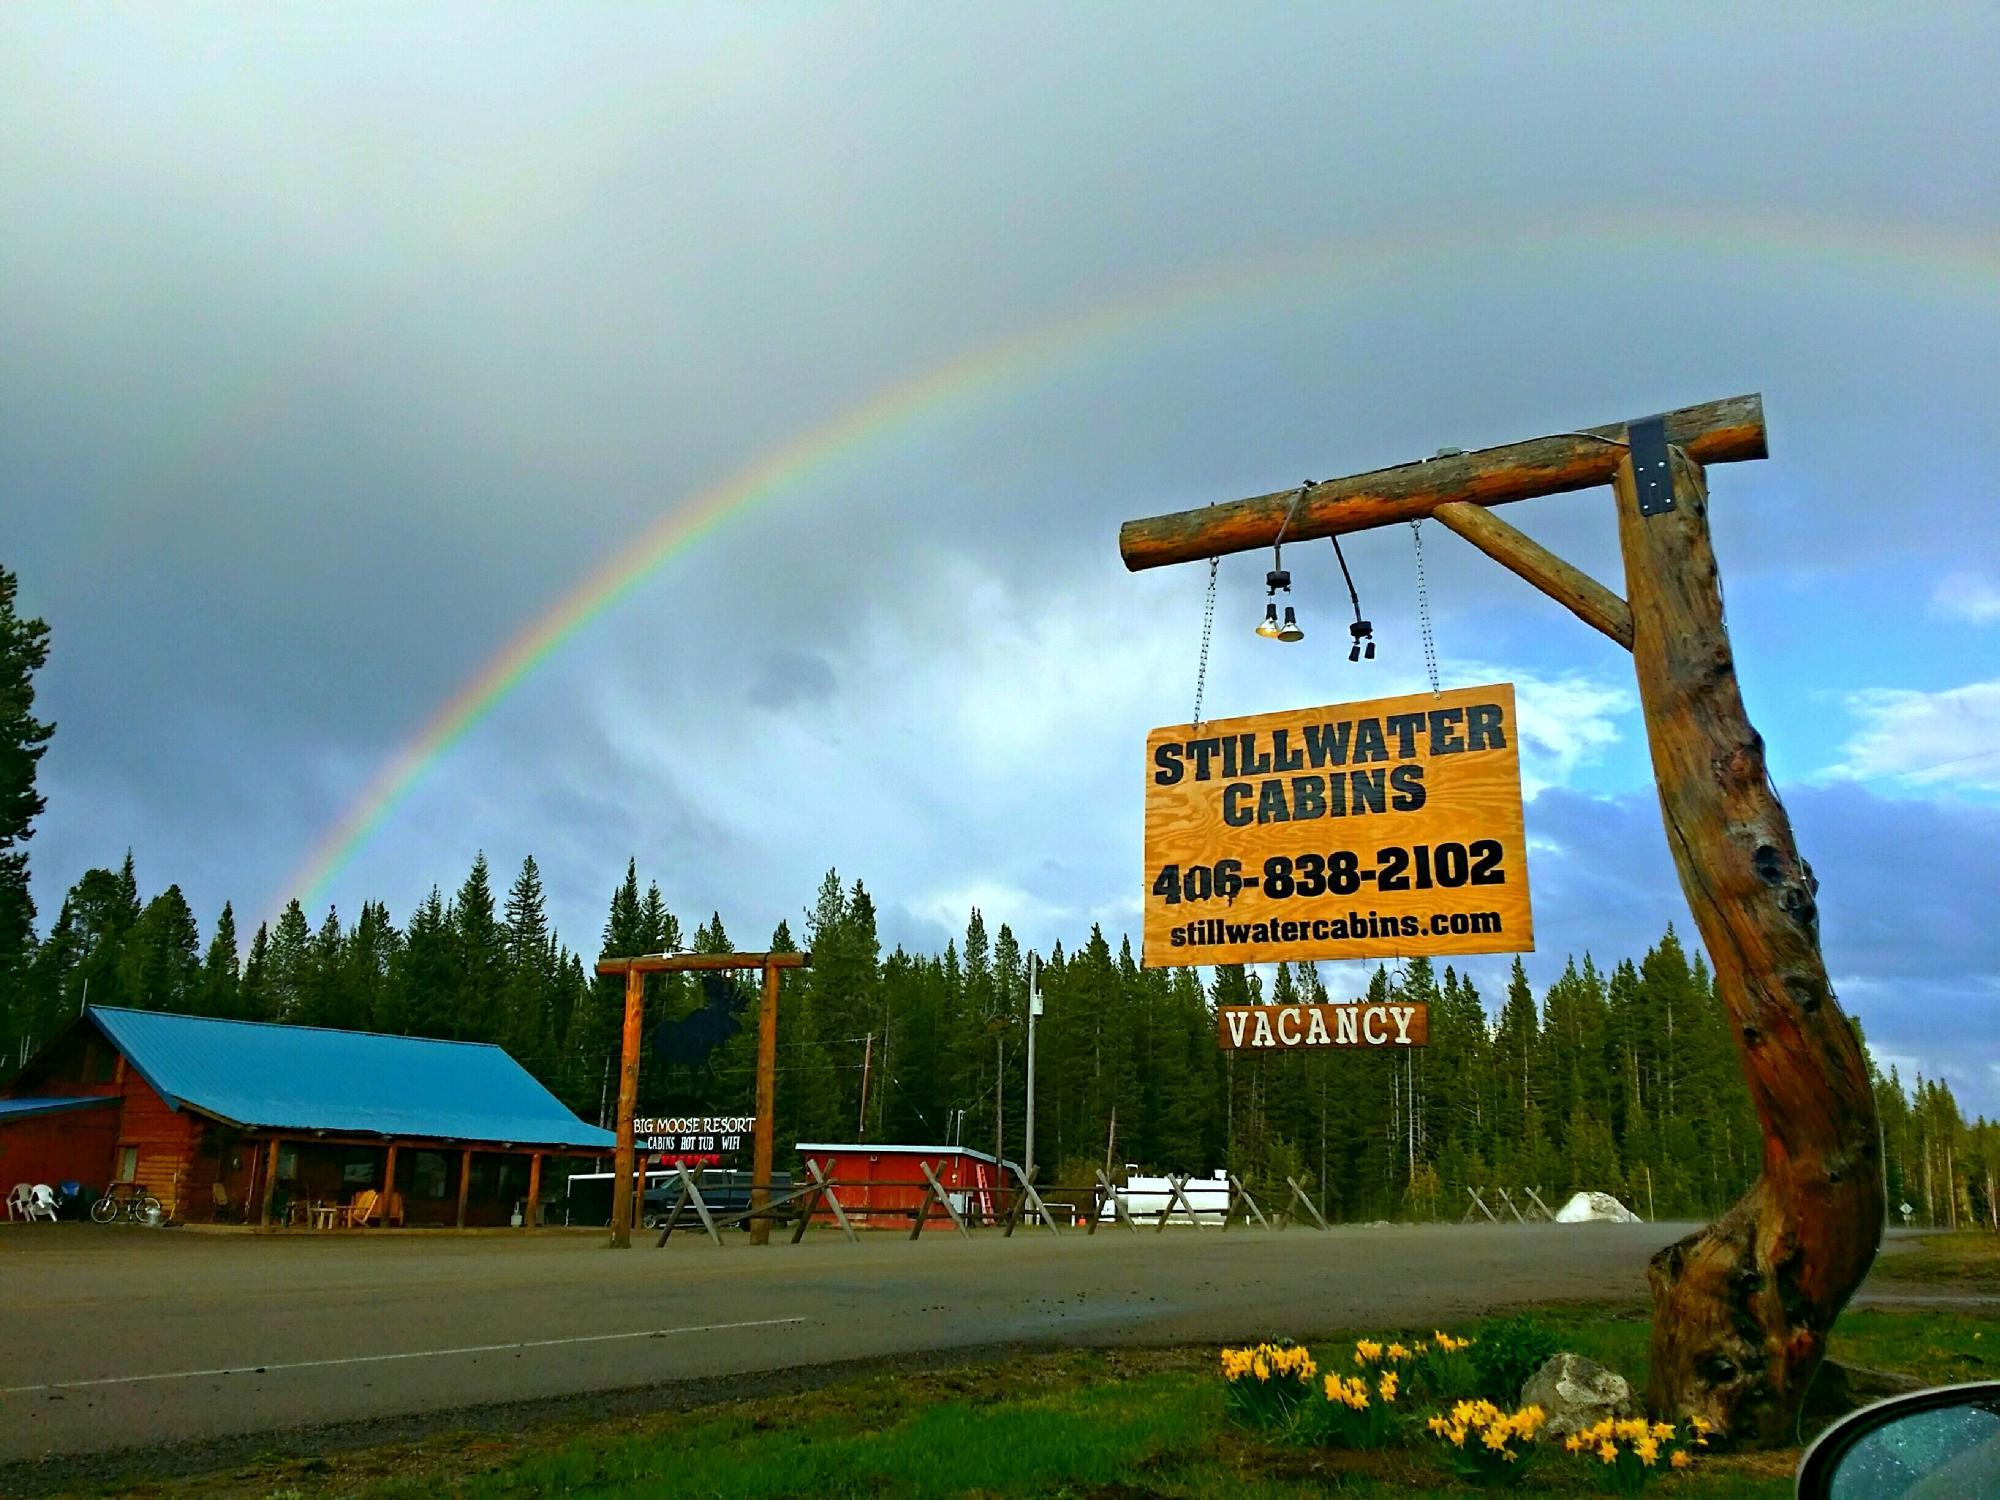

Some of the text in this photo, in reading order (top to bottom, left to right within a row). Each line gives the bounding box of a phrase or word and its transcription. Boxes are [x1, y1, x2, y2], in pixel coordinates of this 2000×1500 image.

[1154, 703, 1507, 786] STILLWATER
[1222, 764, 1427, 828] CABINS
[1152, 839, 1506, 906] 406-838-2102
[1170, 910, 1503, 947] stillwatercabins.com
[1225, 1006, 1416, 1047] VACANCY
[633, 1117, 757, 1134] BIG MOOSE RESORT
[647, 1135, 741, 1150] CABINS HOT TUB WIFI
